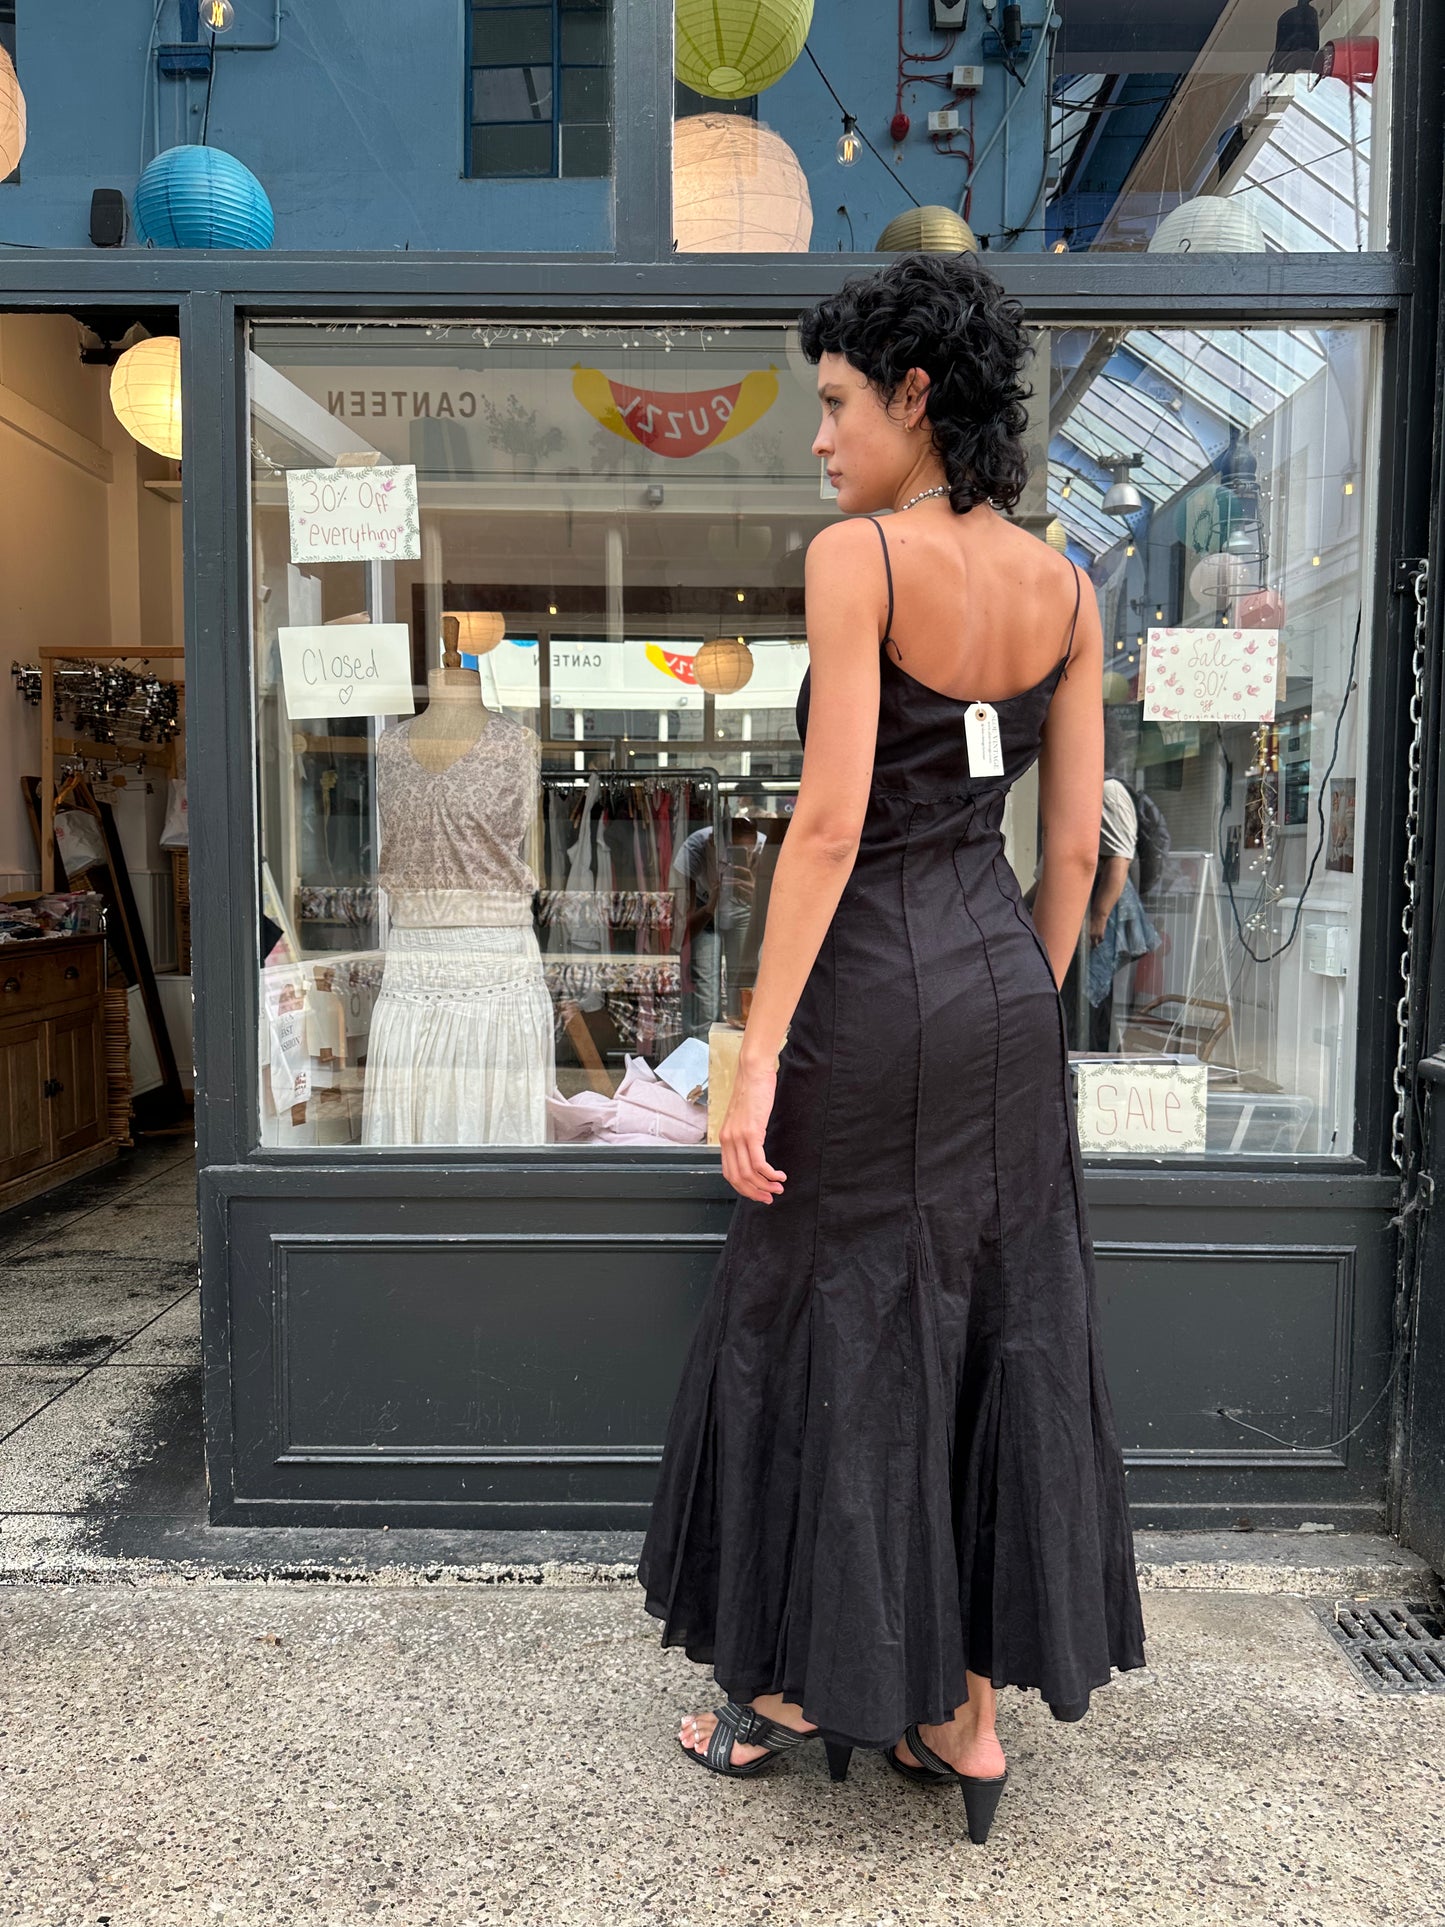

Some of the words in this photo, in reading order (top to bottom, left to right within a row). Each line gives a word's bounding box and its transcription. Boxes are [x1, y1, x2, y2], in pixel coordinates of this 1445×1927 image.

[301, 481, 348, 514] 30%
[309, 522, 397, 554] everything
[302, 648, 379, 685] Closed
[1187, 638, 1241, 667] Sale
[1193, 670, 1228, 699] 30%
